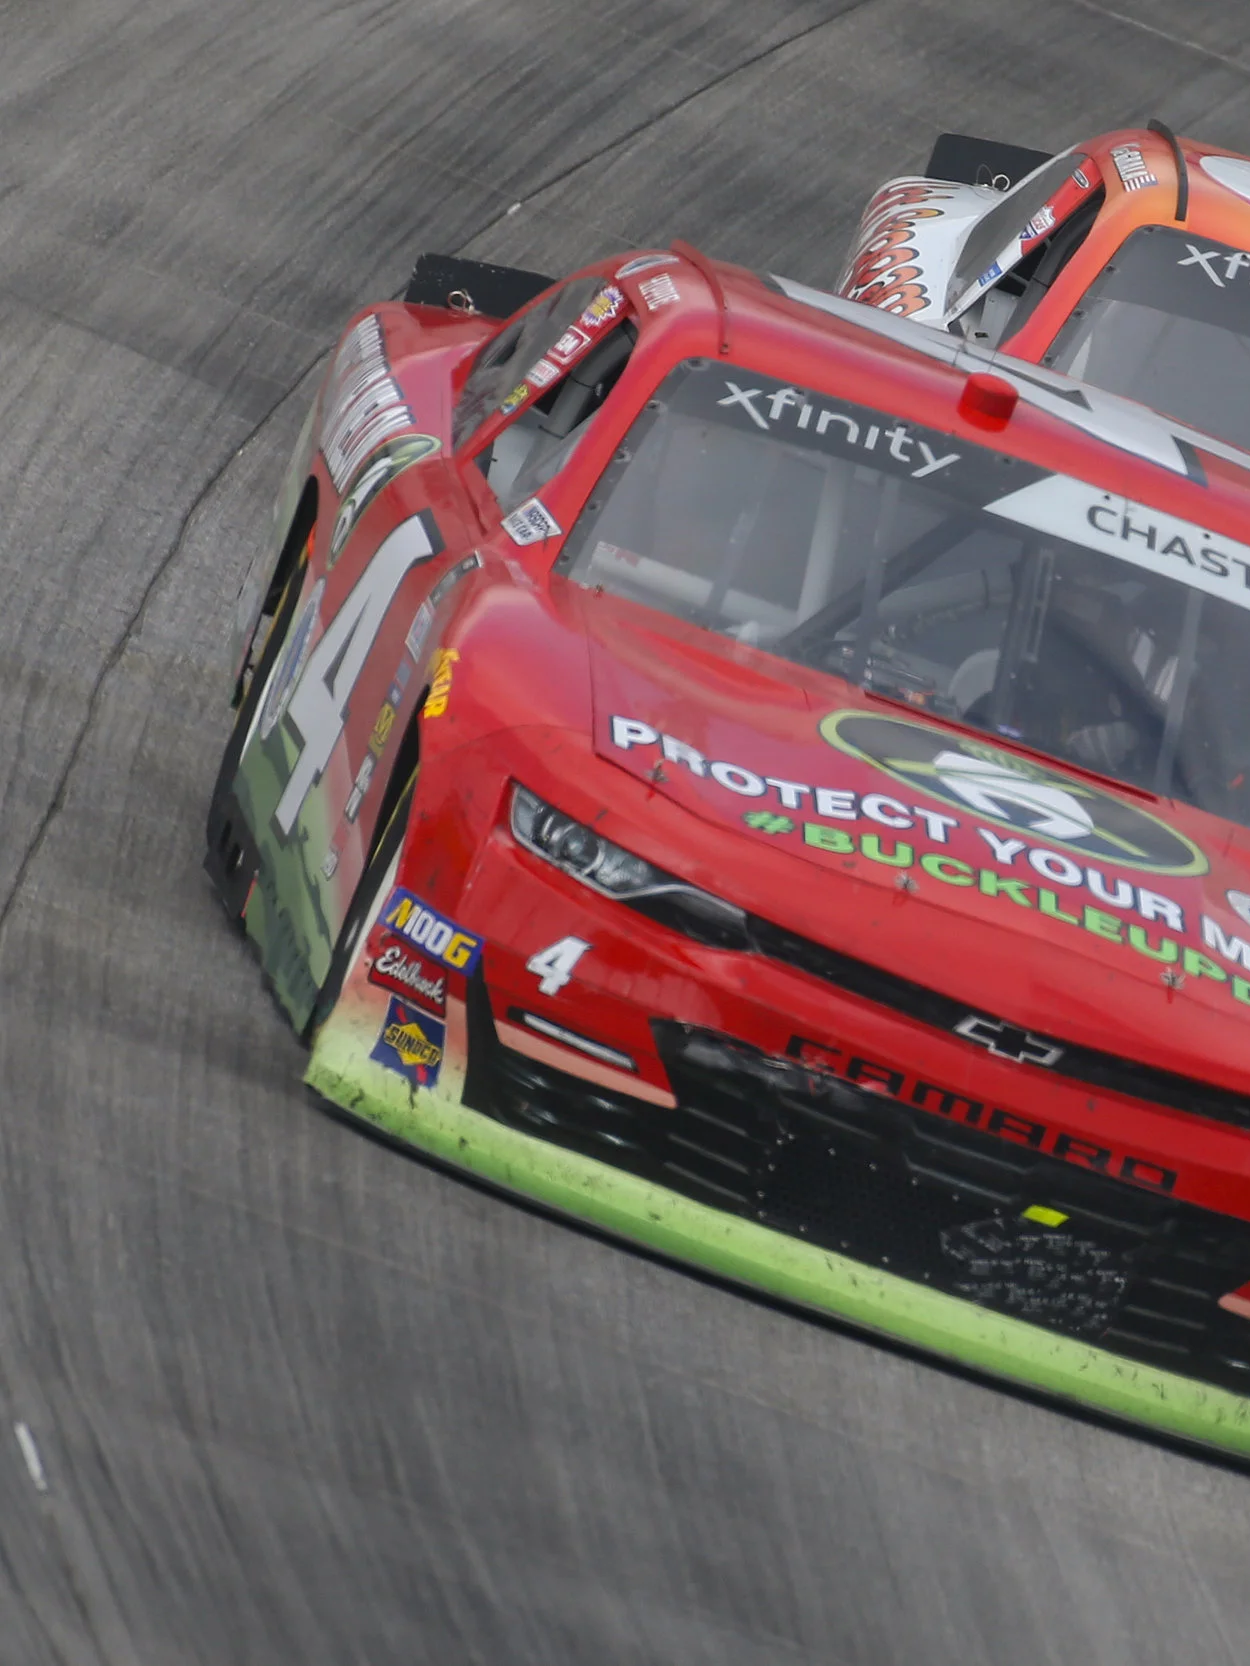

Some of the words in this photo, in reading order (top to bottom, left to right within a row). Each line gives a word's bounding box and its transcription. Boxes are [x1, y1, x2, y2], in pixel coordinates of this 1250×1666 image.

[717, 381, 962, 478] xfinity
[274, 508, 447, 837] 4
[611, 715, 958, 843] PROTECT
[977, 827, 1184, 931] YOUR
[385, 898, 478, 968] MOOG
[526, 936, 594, 996] 4
[384, 1024, 442, 1067] SUNOCO
[785, 1034, 1178, 1194] CAMARO
